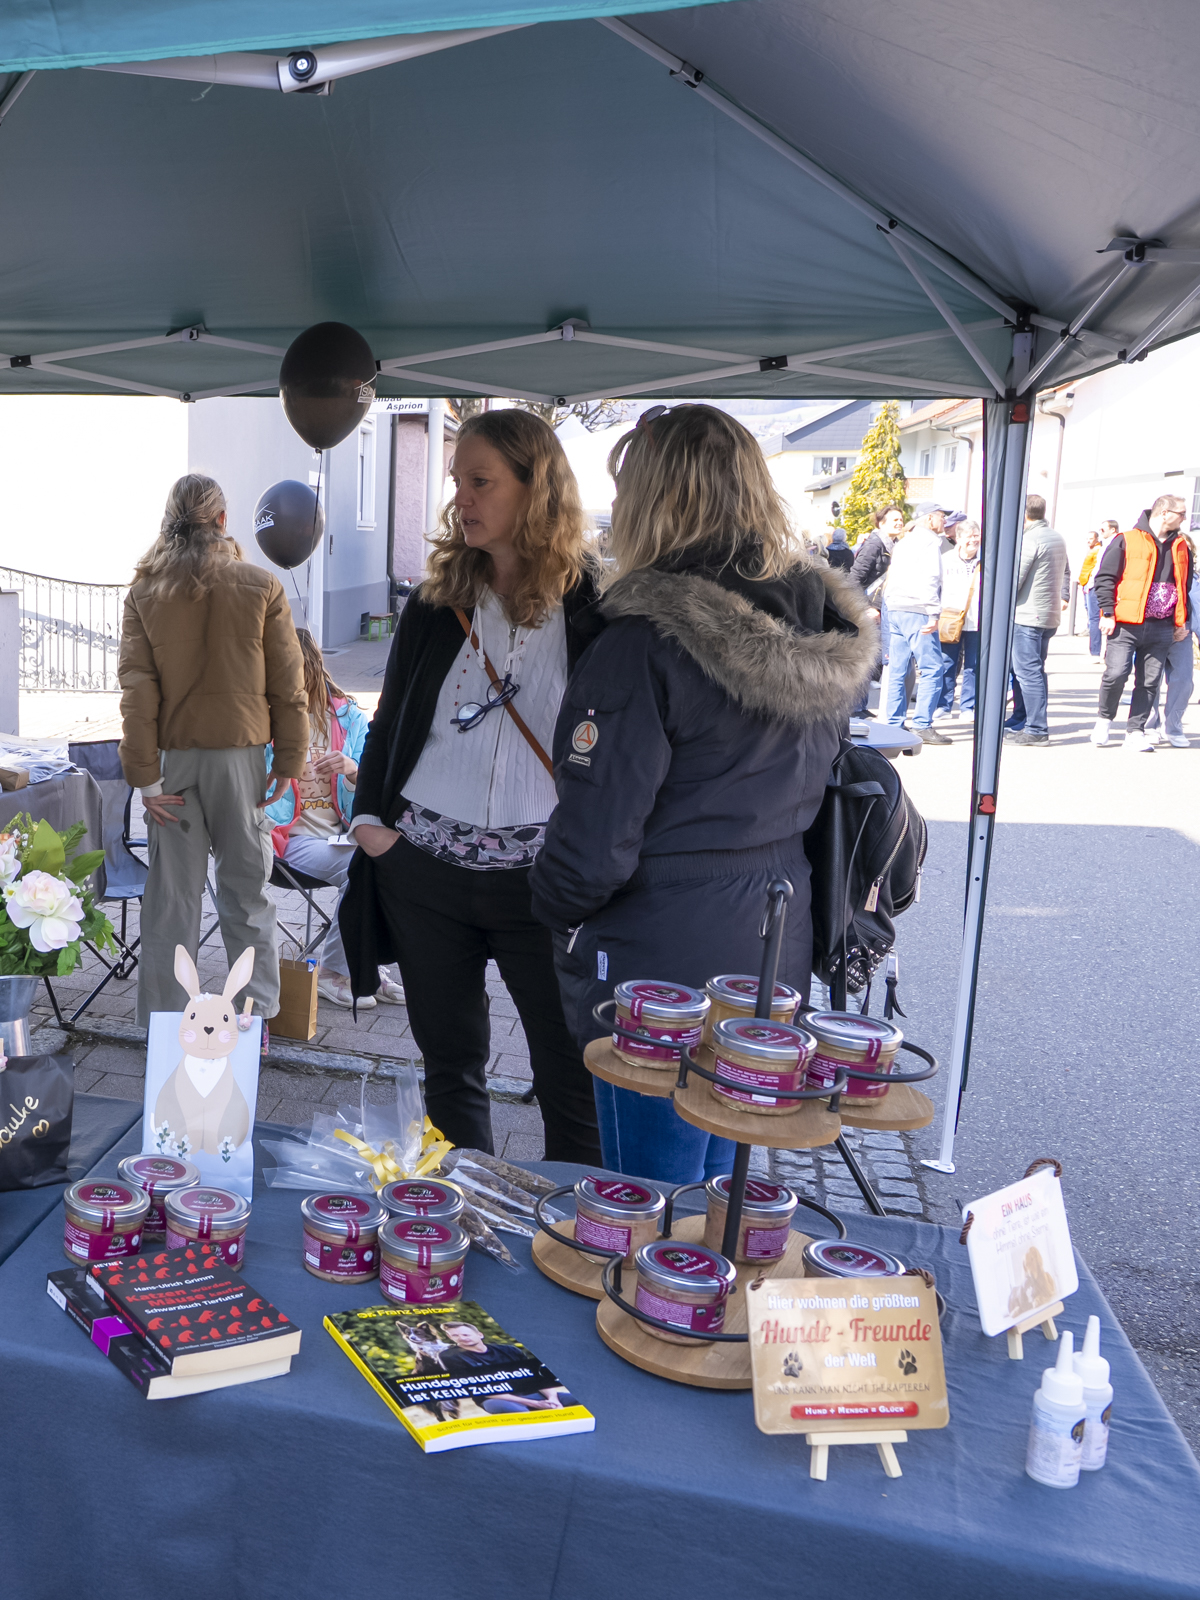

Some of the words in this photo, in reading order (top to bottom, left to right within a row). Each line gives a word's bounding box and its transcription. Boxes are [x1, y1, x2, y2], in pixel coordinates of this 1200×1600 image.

[386, 402, 423, 411] Asprion
[1001, 1202, 1013, 1217] EIN
[1014, 1193, 1032, 1212] HAUS
[125, 1289, 187, 1302] Katzen
[191, 1280, 232, 1293] würden
[134, 1281, 184, 1292] Hans-Ulrich
[185, 1274, 214, 1285] Grimm
[144, 1302, 201, 1315] Schwarzbuch
[202, 1292, 244, 1305] Tierfutter
[148, 1294, 206, 1307] Mäuse
[208, 1284, 246, 1298] kaufen
[768, 1296, 793, 1309] Hier
[798, 1296, 846, 1308] wohnen
[850, 1295, 869, 1308] die
[872, 1294, 919, 1311] größten
[413, 1307, 456, 1315] Spitzer
[760, 1320, 832, 1344] Hunde
[850, 1318, 932, 1343] Freunde
[824, 1354, 844, 1368] der
[849, 1352, 877, 1367] Welt
[399, 1368, 534, 1392] Hundegesundheit
[774, 1384, 790, 1395] UNS
[792, 1384, 817, 1394] KANN
[819, 1384, 840, 1394] MAN
[843, 1383, 868, 1394] NICHT
[872, 1382, 930, 1393] THERAPIEREN
[408, 1392, 429, 1403] ist
[430, 1387, 470, 1400] KEIN
[471, 1382, 513, 1395] Zufall
[436, 1423, 461, 1432] Schritt
[518, 1414, 553, 1422] gesunden
